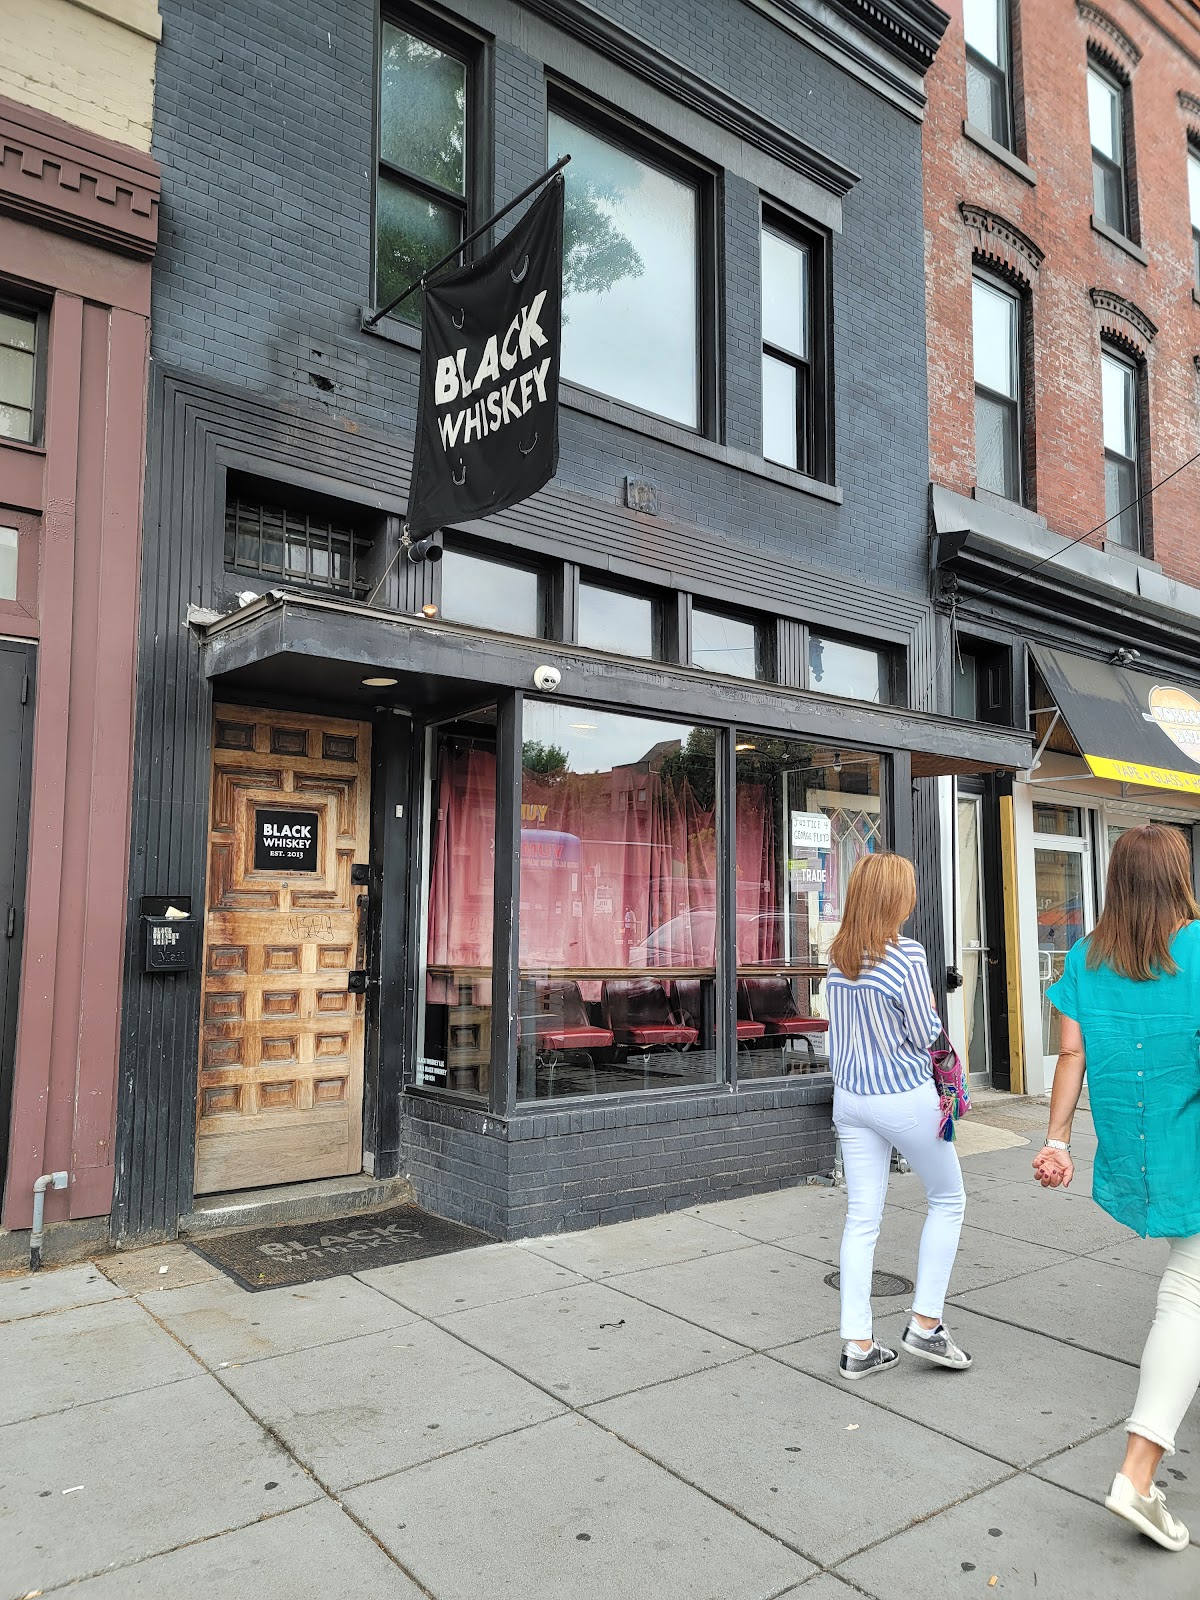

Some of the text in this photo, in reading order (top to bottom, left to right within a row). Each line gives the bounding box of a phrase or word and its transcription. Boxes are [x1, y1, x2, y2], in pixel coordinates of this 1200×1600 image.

[435, 289, 549, 406] BLACK
[437, 357, 551, 452] WHISKEY
[1112, 762, 1143, 780] VAPE
[1150, 770, 1184, 787] GLASS
[263, 823, 312, 838] BLACK
[263, 837, 312, 849] WHISKEY
[287, 851, 304, 859] 2013
[801, 868, 826, 882] TRADE
[256, 1224, 413, 1256] BLACK
[272, 1231, 423, 1263] WHISKEY
